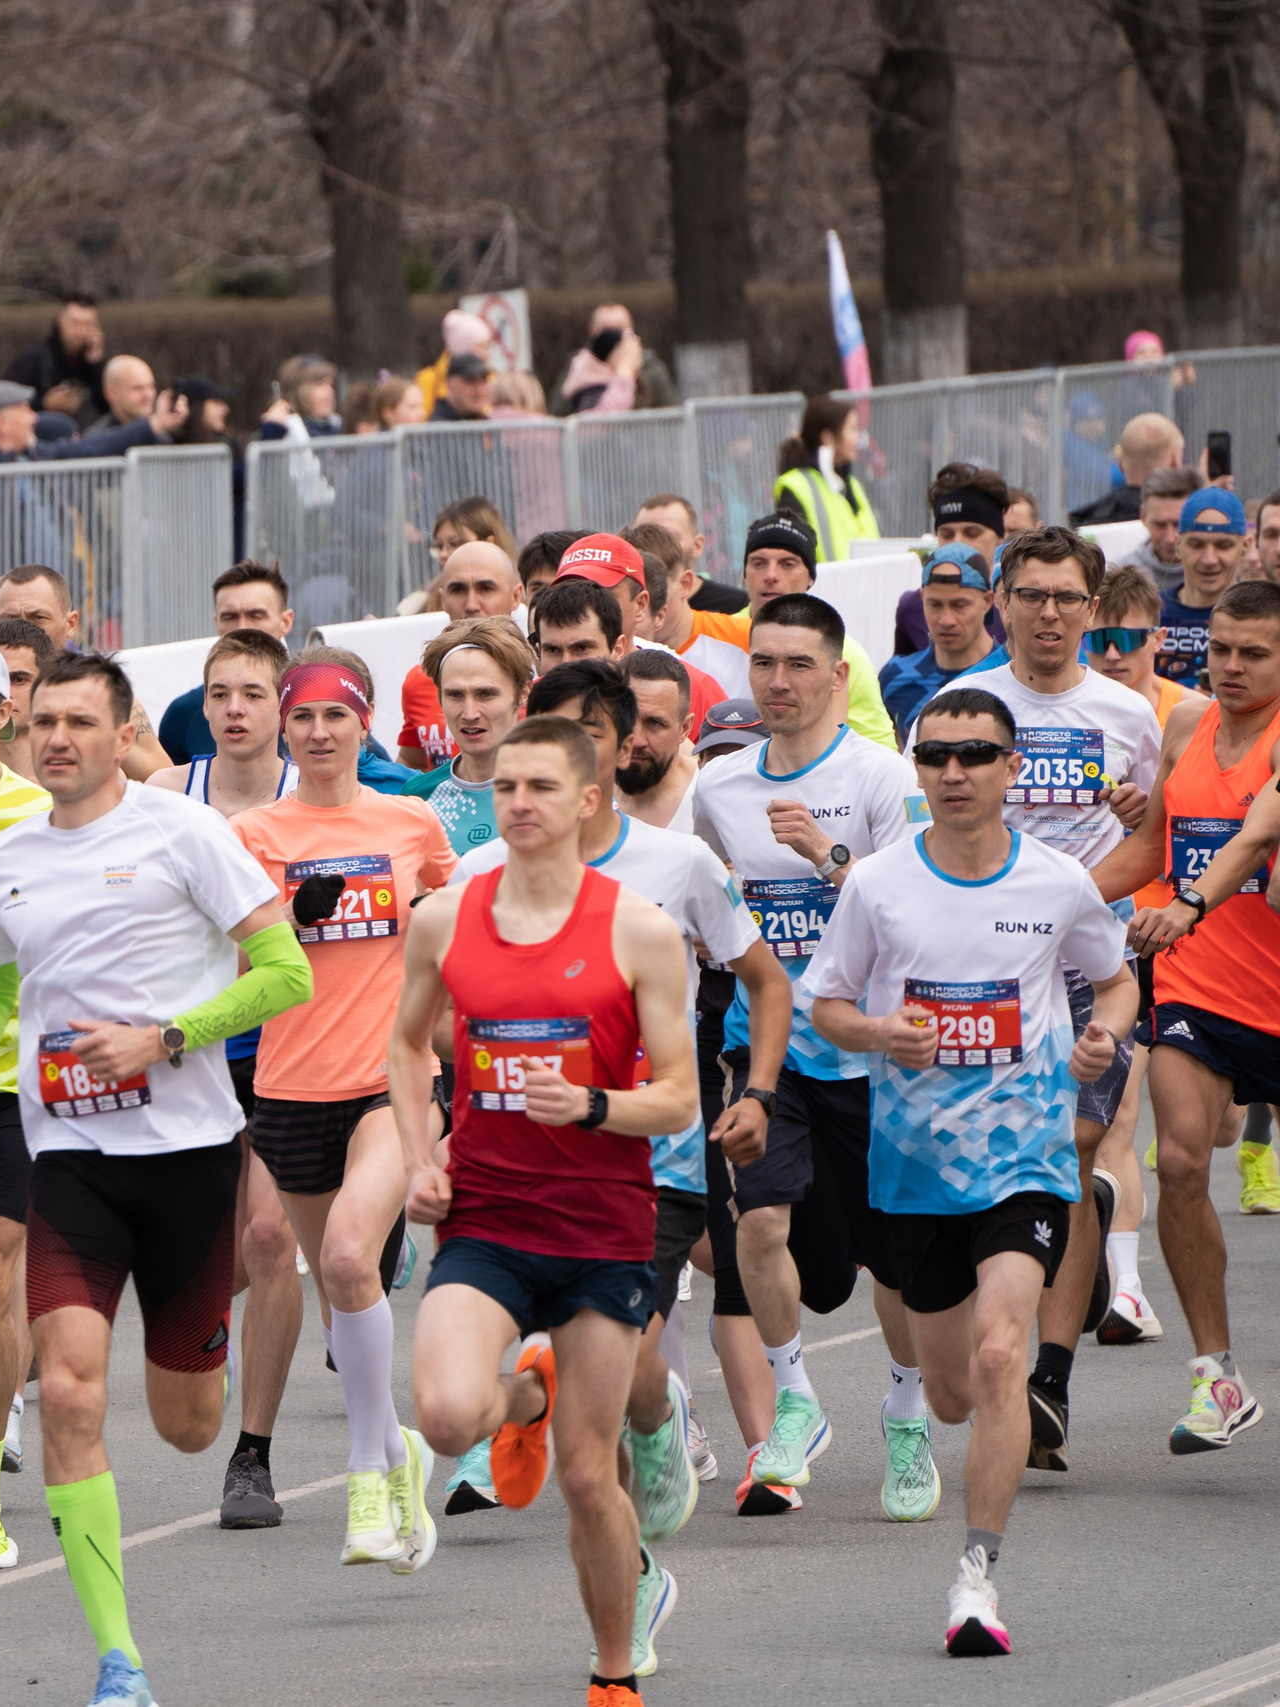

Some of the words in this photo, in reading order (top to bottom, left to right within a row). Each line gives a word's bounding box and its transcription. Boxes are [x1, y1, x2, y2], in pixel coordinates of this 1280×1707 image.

[559, 548, 613, 569] RUSSIA
[1161, 639, 1210, 652] ОСМ
[1027, 747, 1068, 755] АЛЕКСАНДР
[1017, 758, 1084, 787] 2035
[834, 805, 851, 818] KZ
[322, 860, 360, 869] ПРОСТО
[1186, 847, 1222, 876] 23
[765, 909, 827, 940] 2194
[994, 922, 1028, 934] RUN
[1032, 922, 1054, 934] KZ
[942, 1004, 973, 1012] РУСЛАН
[1164, 1028, 1194, 1041] adidas
[492, 1055, 564, 1090] 157
[59, 1064, 118, 1097] 18
